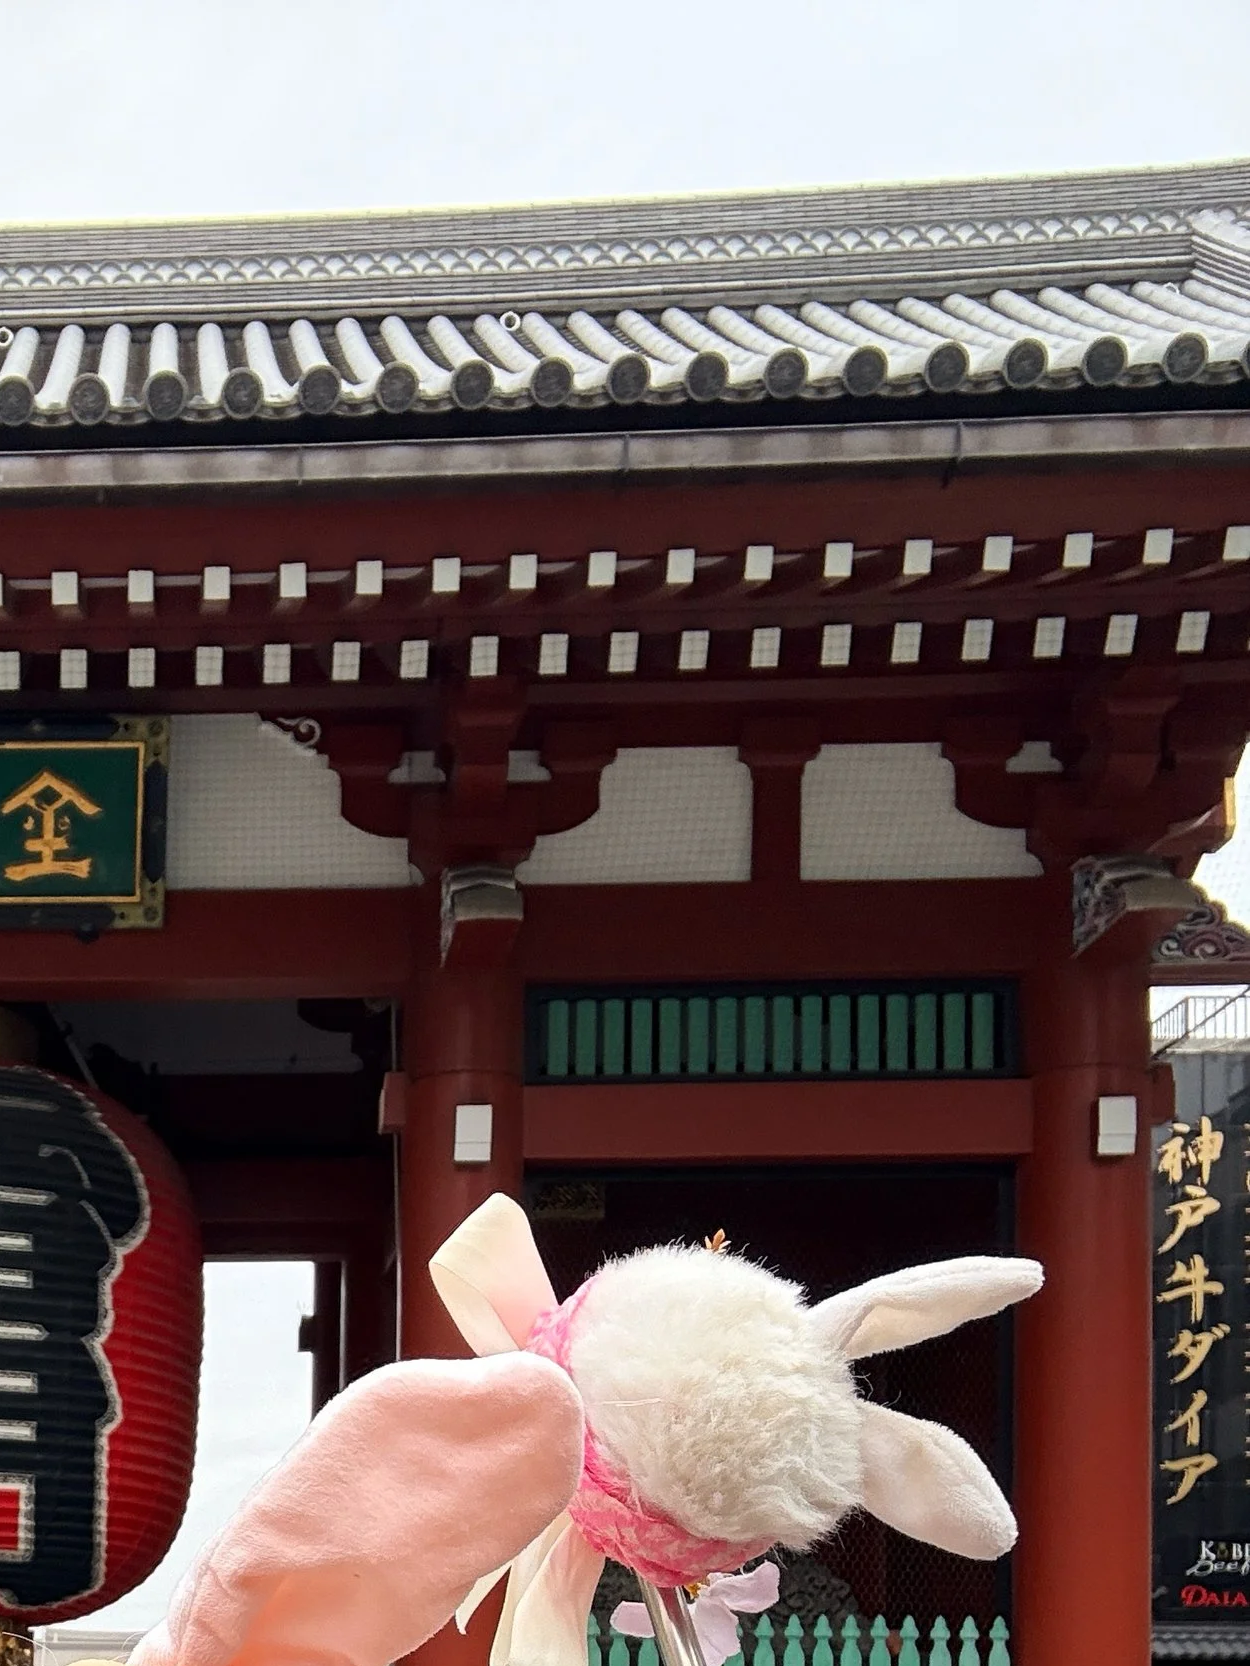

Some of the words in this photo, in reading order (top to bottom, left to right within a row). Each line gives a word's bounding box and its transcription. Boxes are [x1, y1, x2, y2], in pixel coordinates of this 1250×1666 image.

[1157, 1114, 1232, 1505] 神戸牛ダイア
